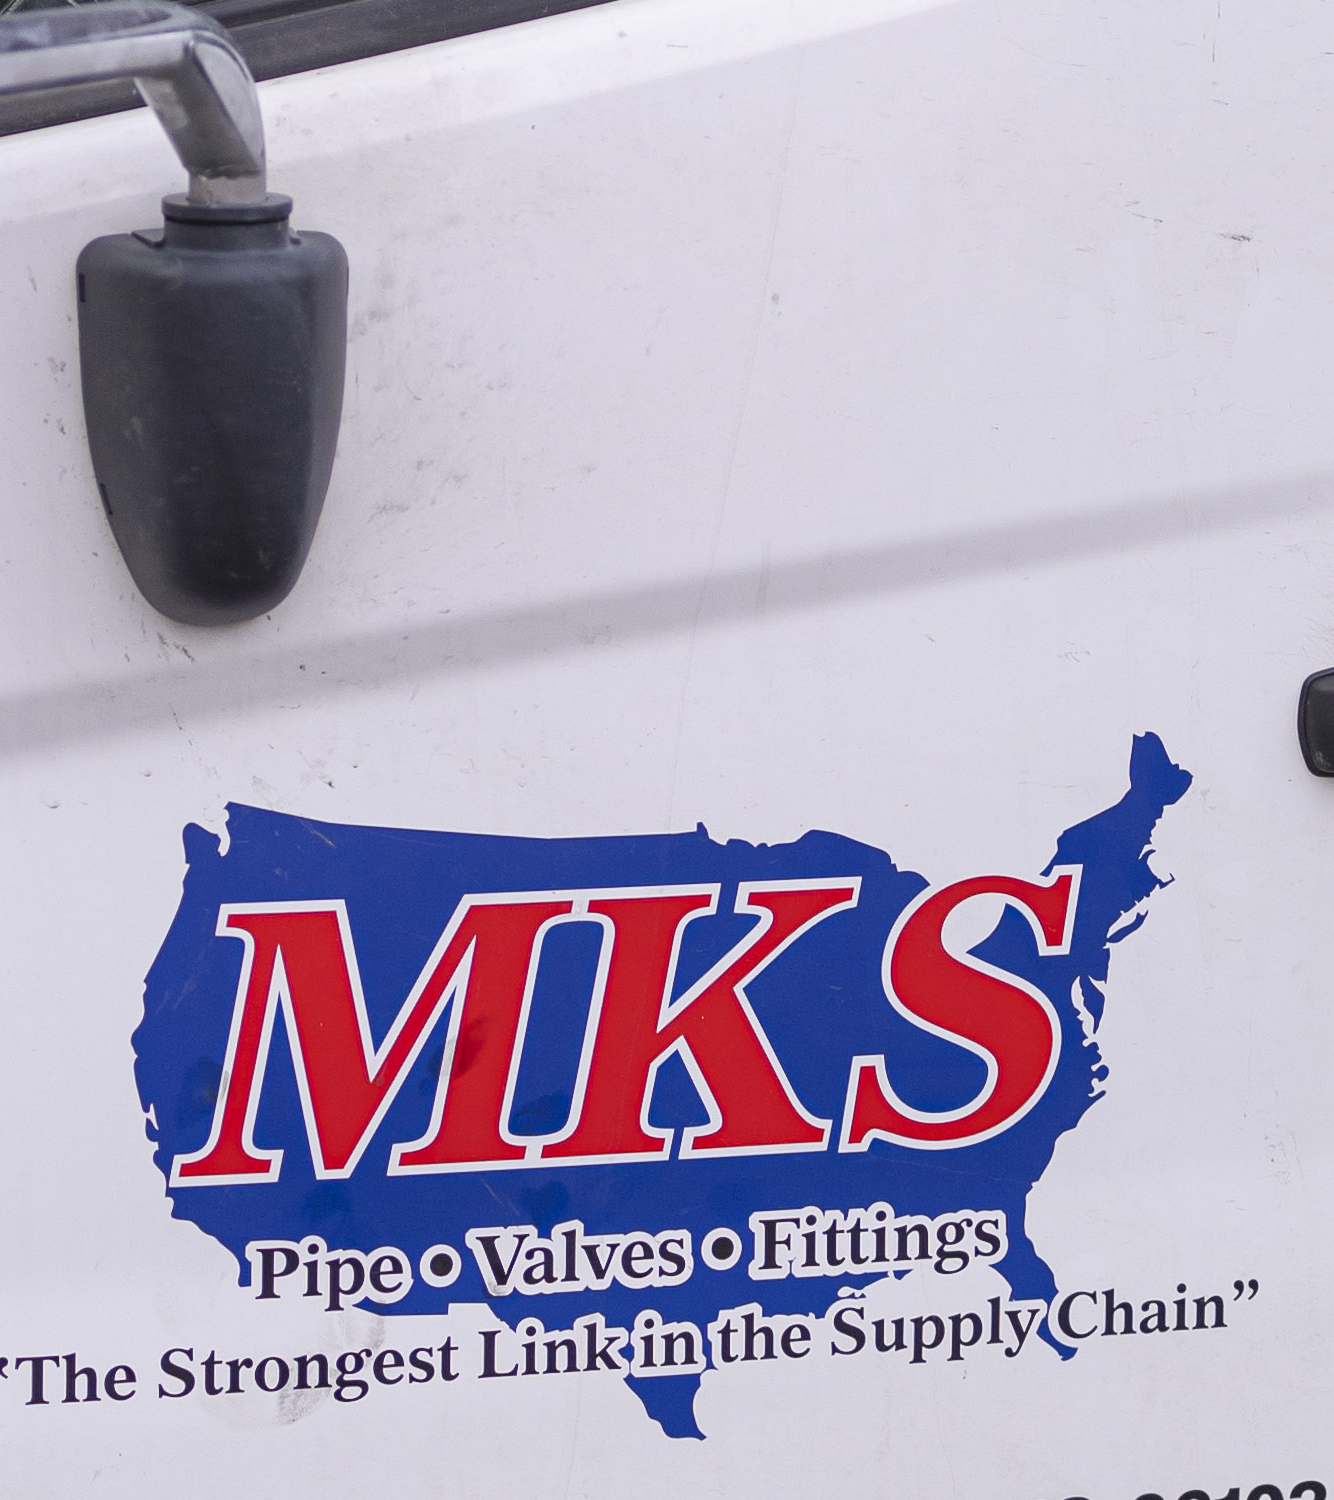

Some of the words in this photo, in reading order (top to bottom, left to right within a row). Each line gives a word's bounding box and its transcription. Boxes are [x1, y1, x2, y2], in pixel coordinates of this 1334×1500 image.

[170, 866, 1081, 1186] MKS
[255, 1243, 404, 1312] Pipe
[475, 1229, 686, 1286] Valves
[758, 1210, 1001, 1275] Fittings
[158, 1336, 460, 1403] Strongest
[478, 1322, 622, 1379] Link
[639, 1318, 698, 1368] in
[717, 1312, 811, 1363] the
[831, 1296, 1040, 1364] Supply
[1057, 1279, 1259, 1339] Chain”
